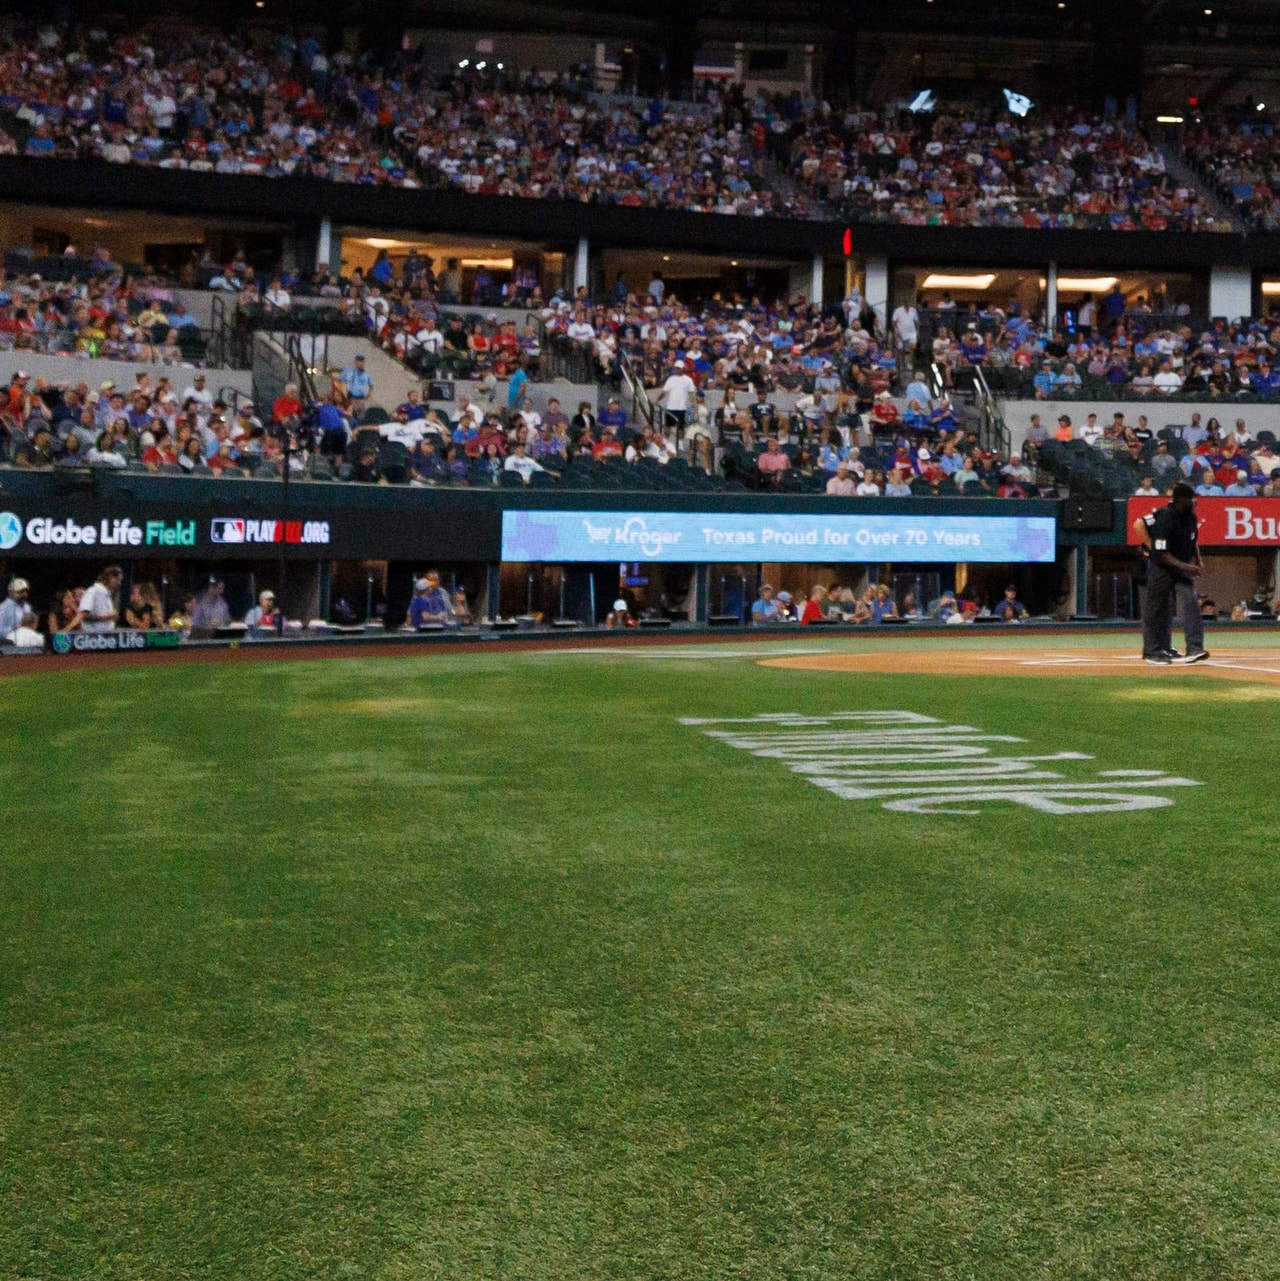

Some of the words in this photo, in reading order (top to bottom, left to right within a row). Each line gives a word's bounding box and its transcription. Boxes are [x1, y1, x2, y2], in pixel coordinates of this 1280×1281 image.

[25, 517, 98, 545] Globe
[100, 519, 143, 546] Life
[145, 520, 197, 546] Field
[246, 519, 330, 543] PLAY.ORG
[614, 517, 682, 557] Kroger
[703, 528, 756, 545] Texas
[761, 528, 818, 545] Proud
[823, 529, 850, 545] for
[855, 529, 899, 546] Over
[905, 529, 928, 546] 70
[932, 530, 981, 546] Years
[119, 630, 145, 649] Life
[700, 725, 1205, 815] Mobile
